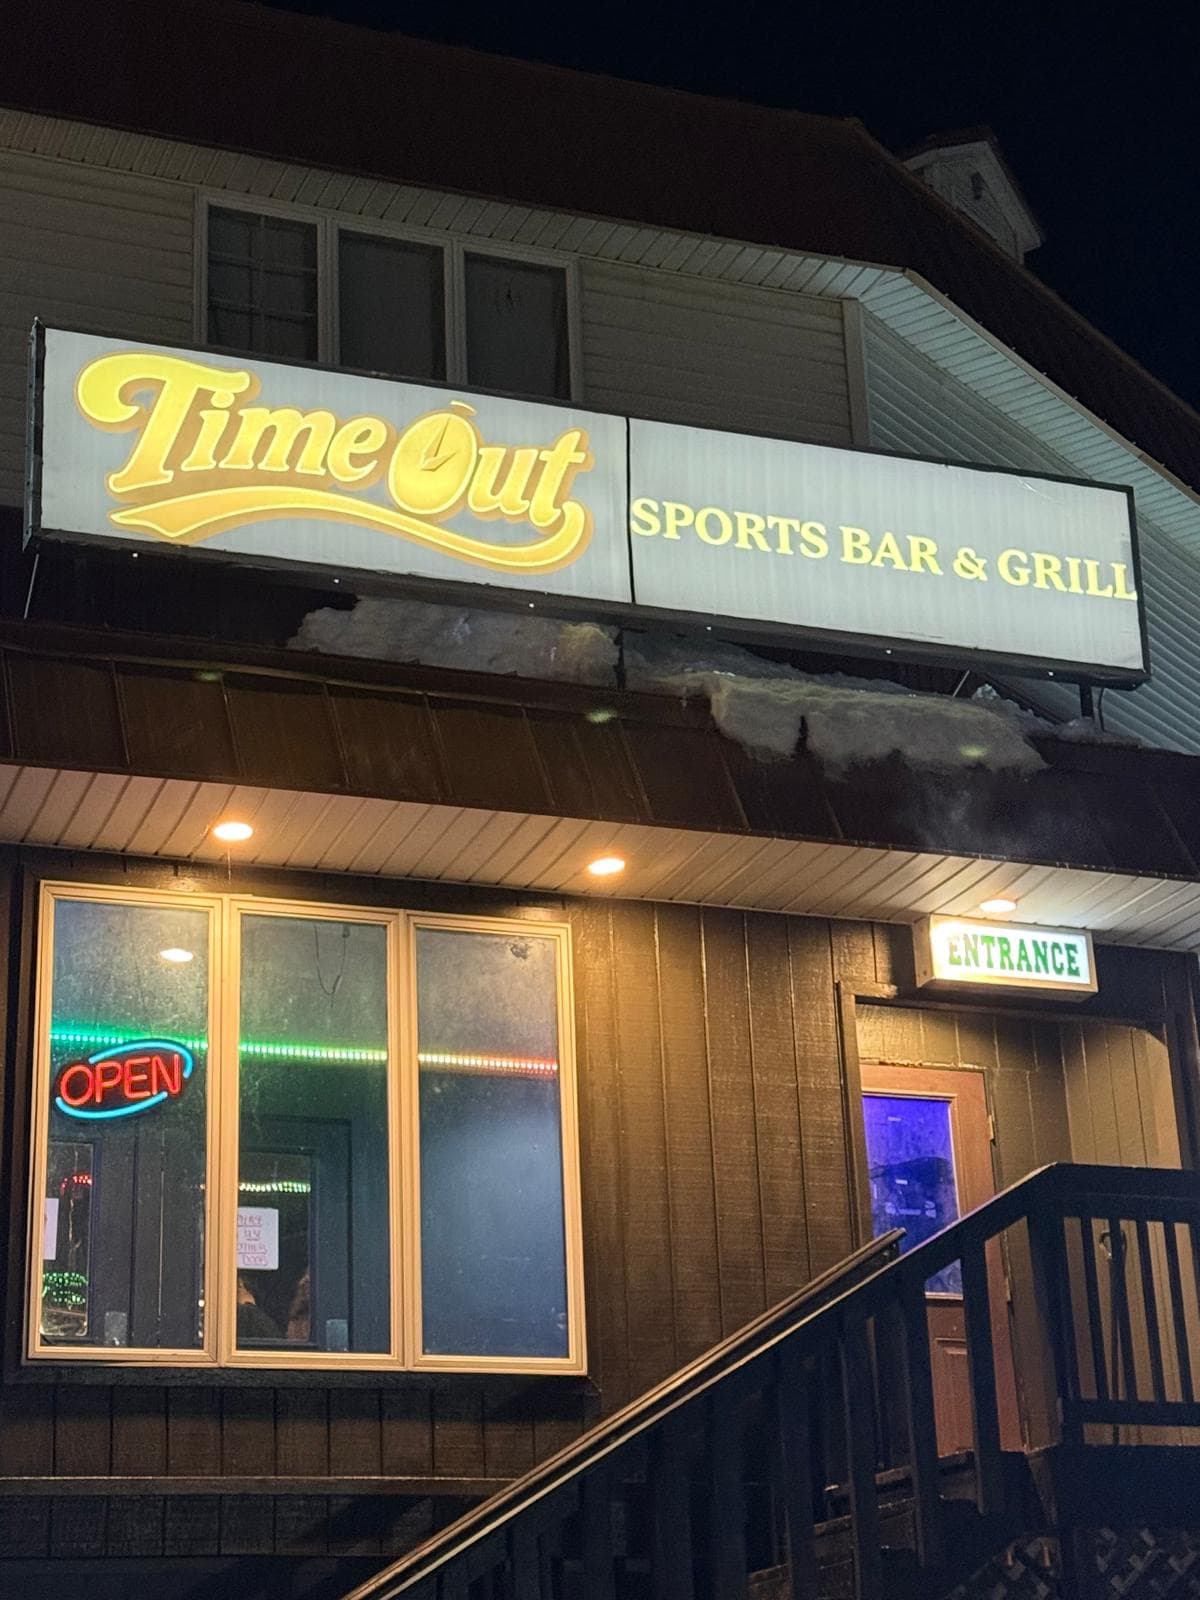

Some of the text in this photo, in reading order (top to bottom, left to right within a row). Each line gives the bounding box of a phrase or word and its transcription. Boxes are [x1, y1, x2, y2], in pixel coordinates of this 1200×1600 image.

[77, 352, 586, 528] Time Out
[630, 497, 1138, 601] SPORTS BAR & GRILL
[948, 934, 1081, 977] ENTRANCE
[59, 1053, 182, 1106] OPEN
